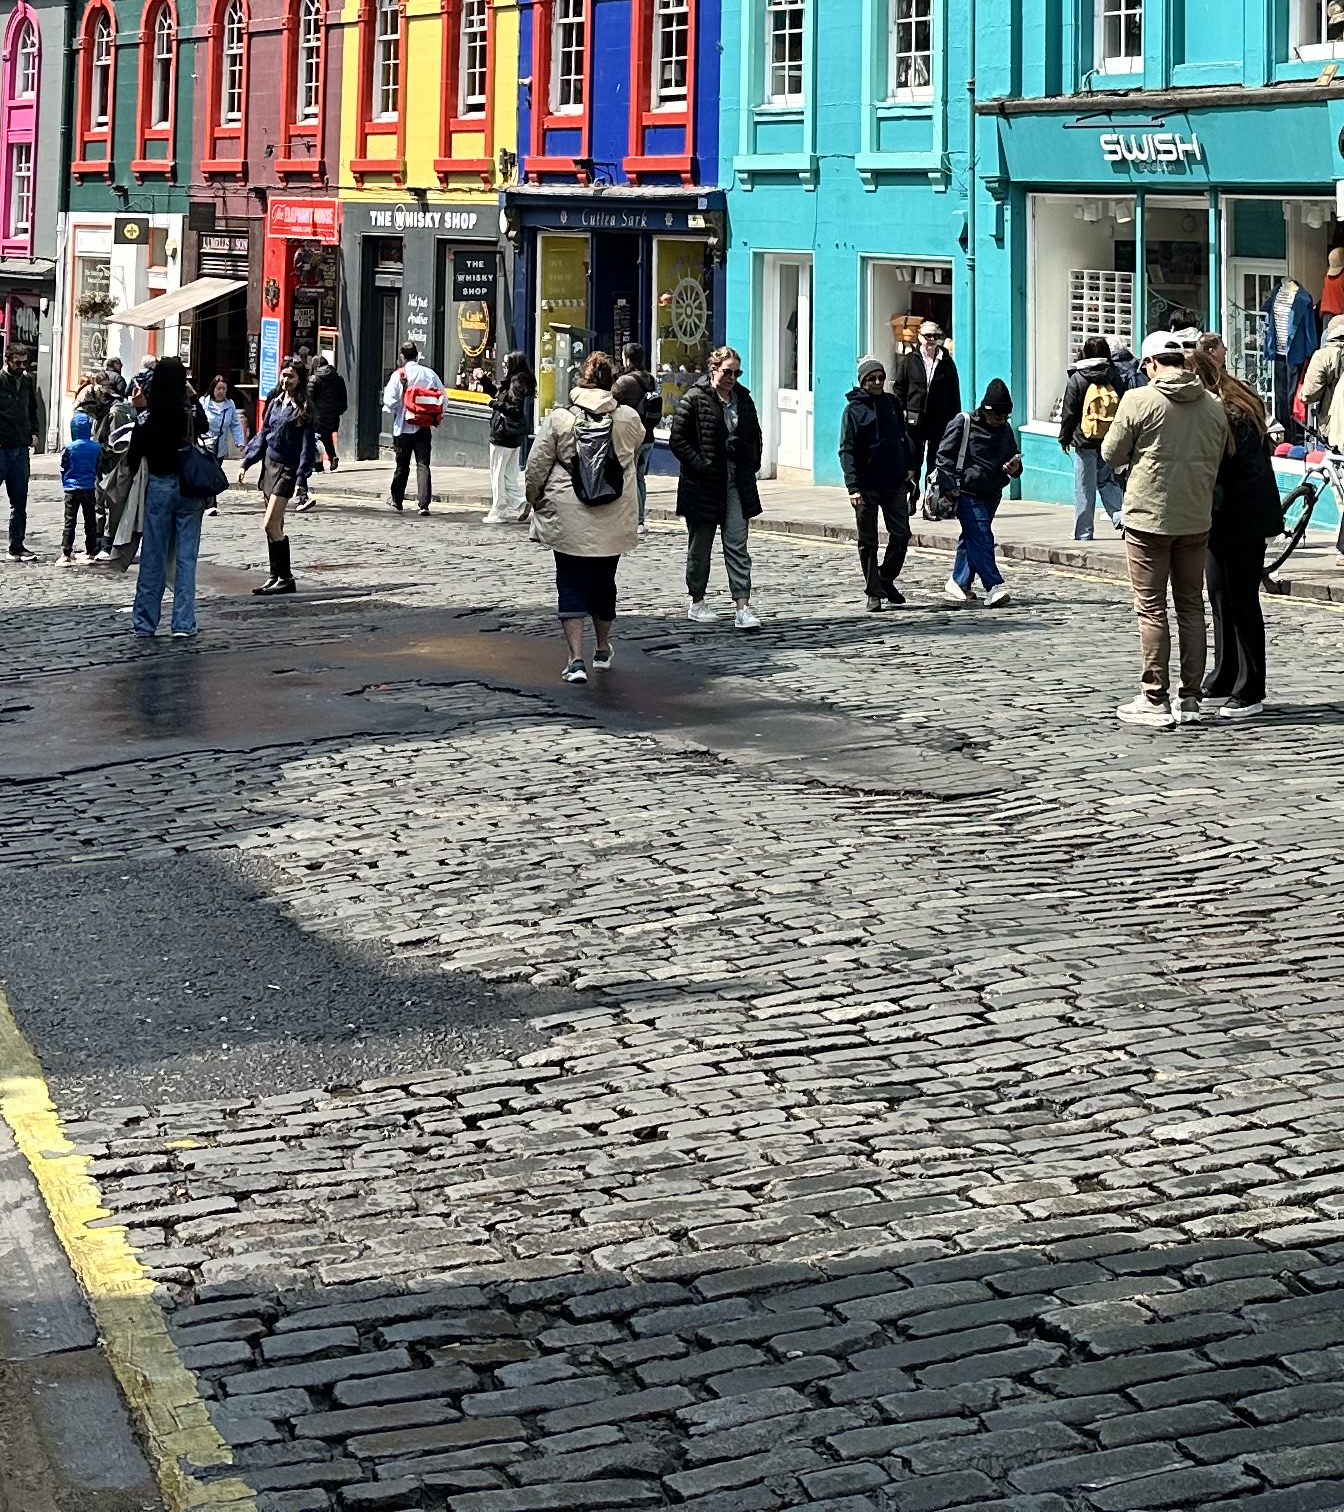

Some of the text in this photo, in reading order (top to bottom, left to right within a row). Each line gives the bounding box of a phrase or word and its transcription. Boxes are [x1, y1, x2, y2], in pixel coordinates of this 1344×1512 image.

[1100, 133, 1202, 161] SWISH
[370, 209, 477, 229] THE WHISKY SHOP
[621, 209, 648, 228] Sark
[457, 273, 494, 283] WHISKY
[462, 287, 488, 296] SHOP
